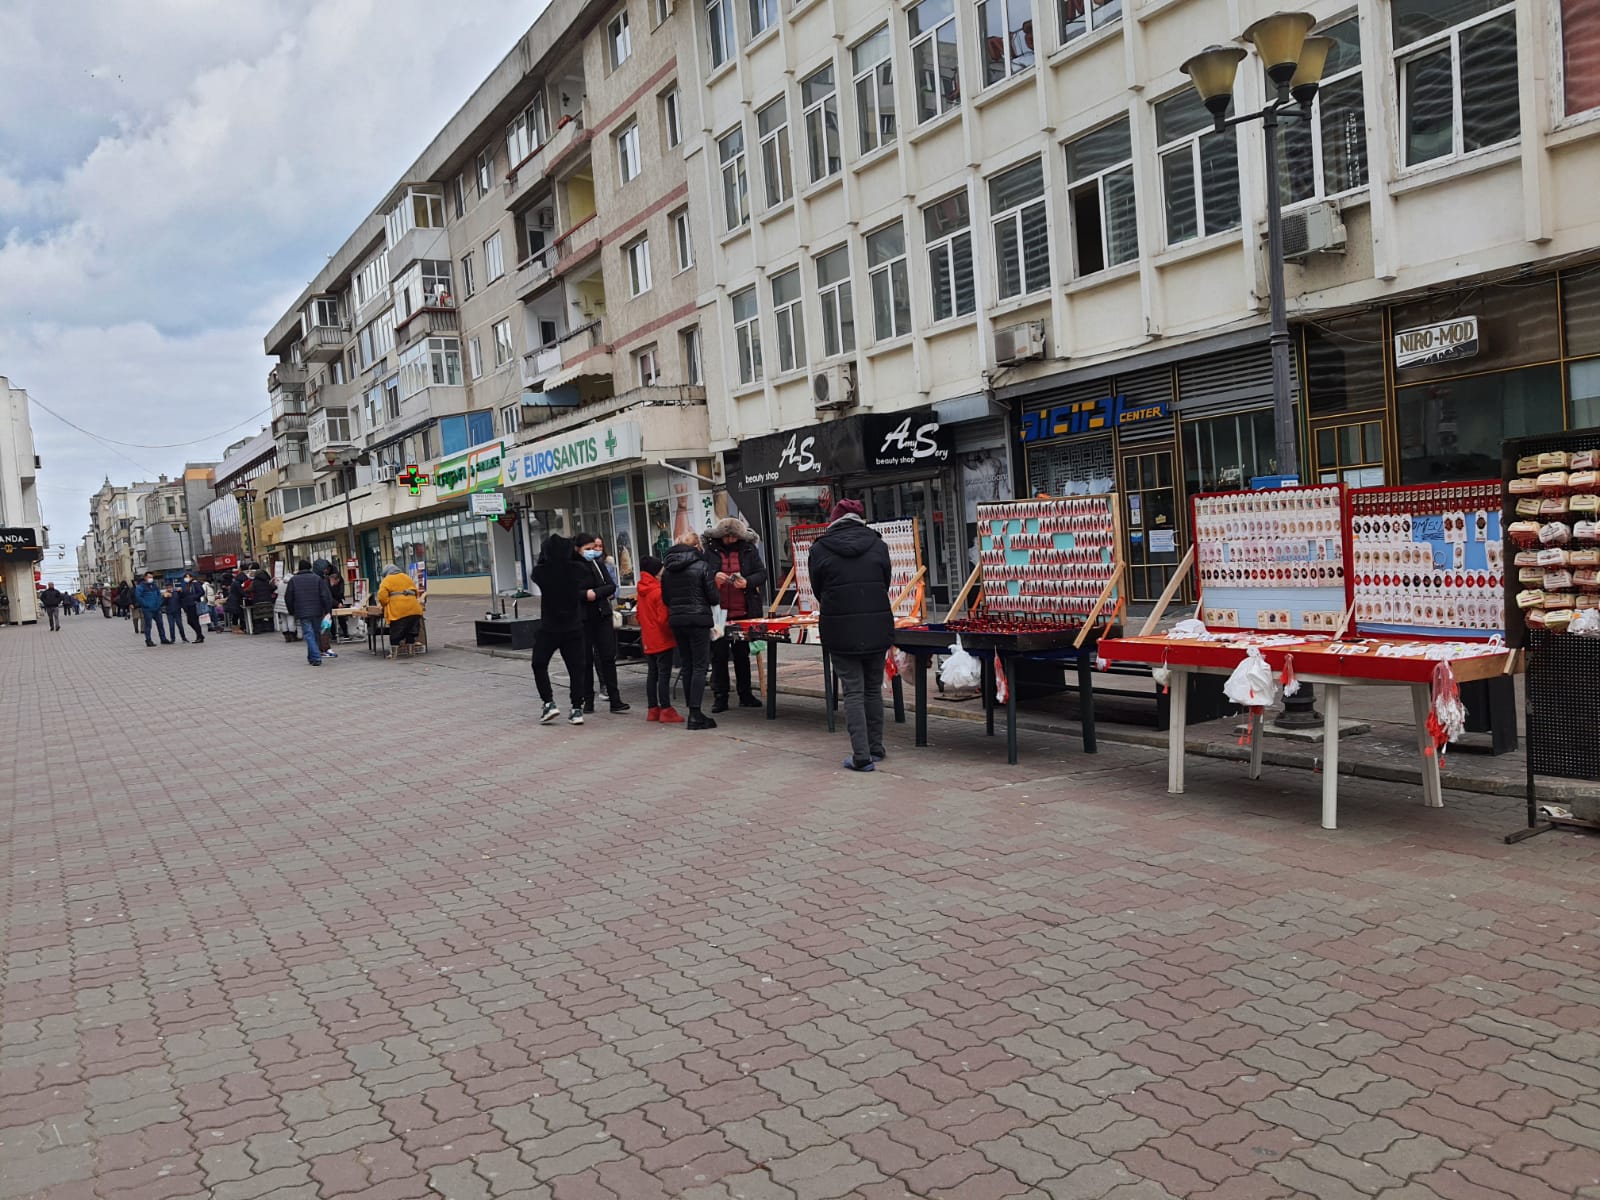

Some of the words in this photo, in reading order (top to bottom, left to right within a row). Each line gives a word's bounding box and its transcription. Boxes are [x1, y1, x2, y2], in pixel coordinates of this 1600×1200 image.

[1399, 321, 1474, 353] NIRO-MOD
[1119, 406, 1162, 423] CENTER
[524, 437, 598, 478] EUROSANTIS
[875, 456, 899, 466] beauty
[899, 455, 916, 464] shop
[745, 472, 764, 484] beauty
[765, 471, 779, 481] shop
